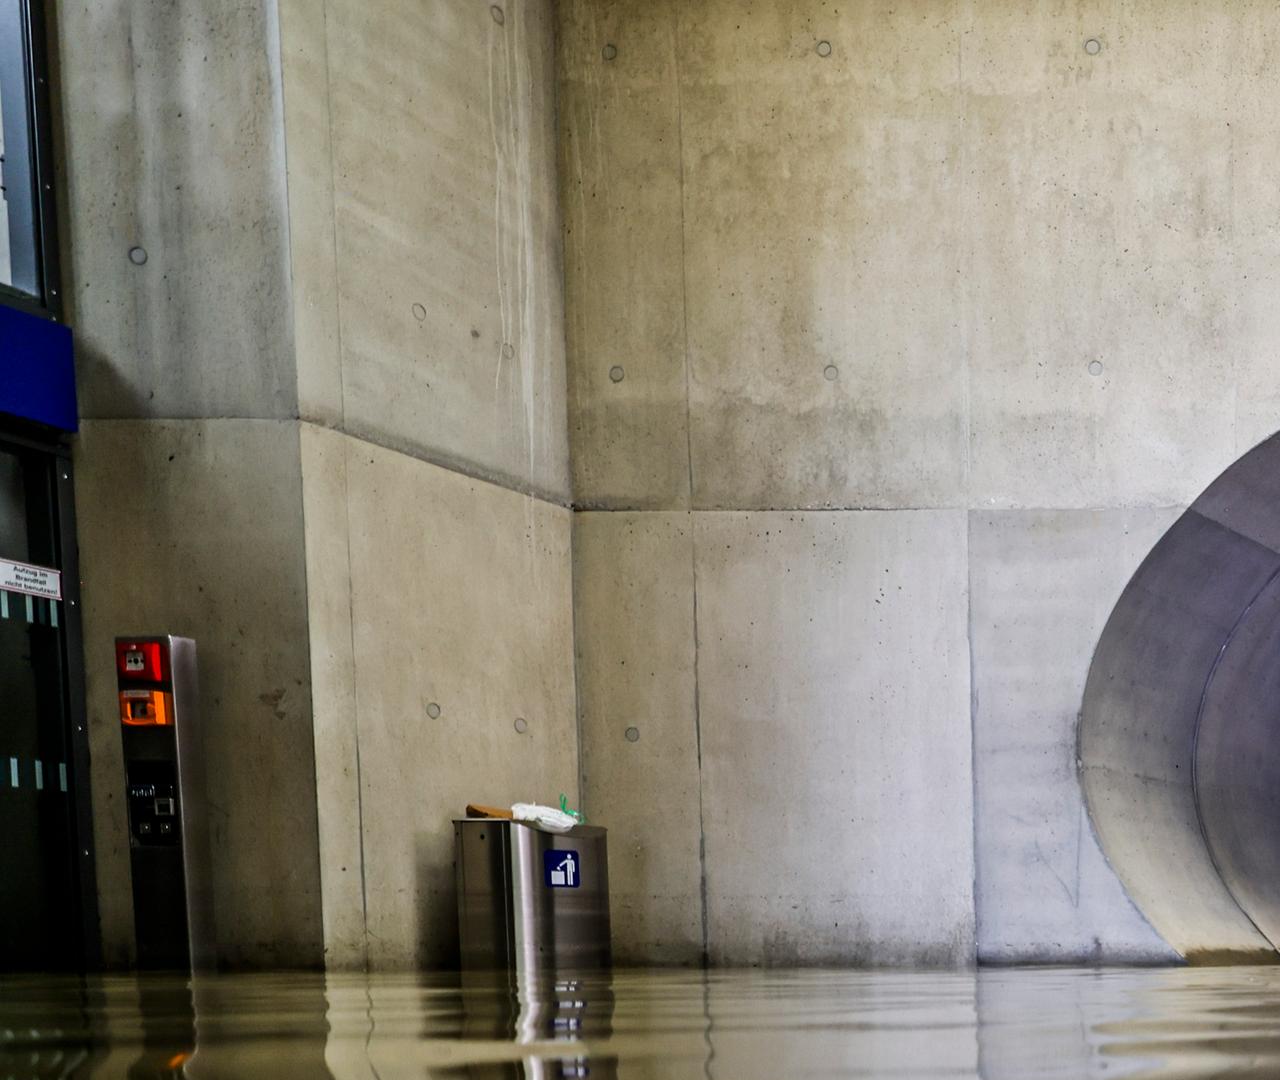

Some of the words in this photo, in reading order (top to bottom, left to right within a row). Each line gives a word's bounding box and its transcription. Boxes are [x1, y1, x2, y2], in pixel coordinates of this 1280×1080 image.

[14, 566, 37, 577] Aufzug
[5, 580, 23, 588] nicht
[16, 574, 46, 585] Brandfall
